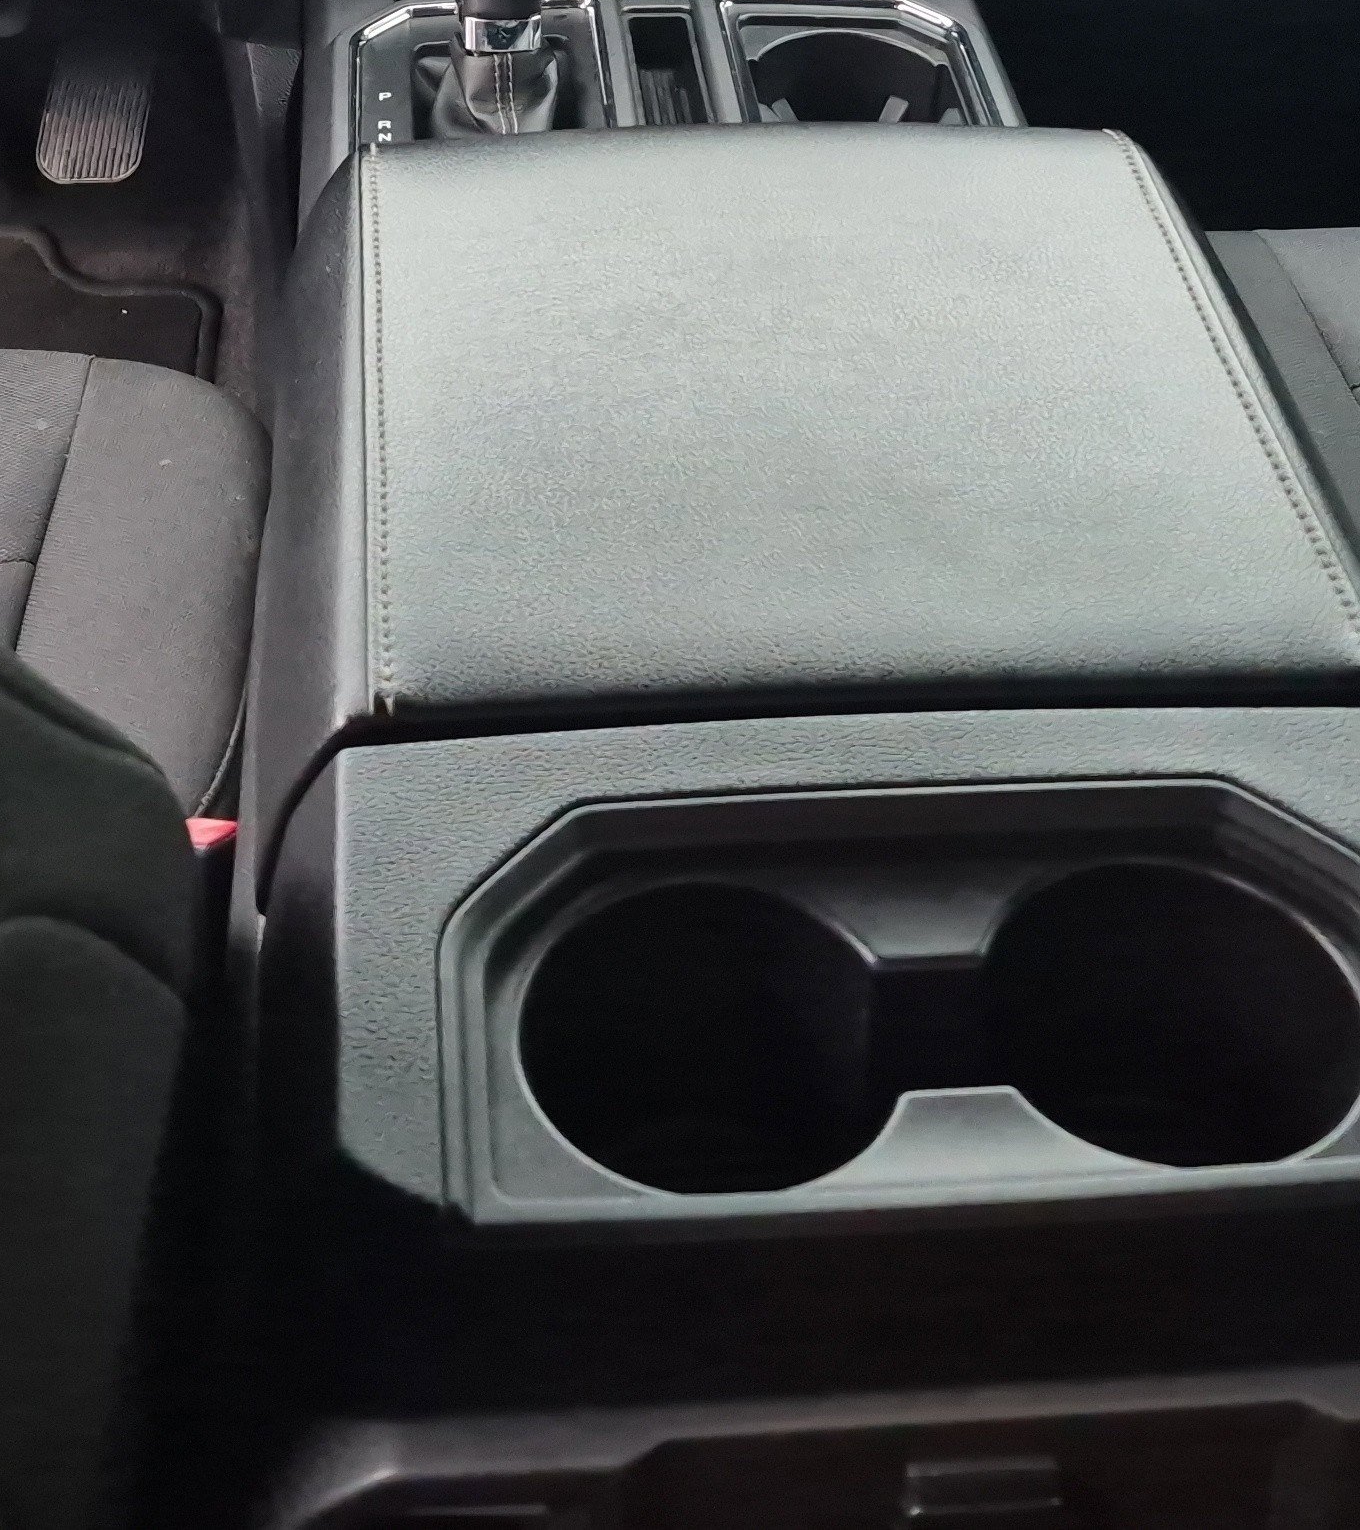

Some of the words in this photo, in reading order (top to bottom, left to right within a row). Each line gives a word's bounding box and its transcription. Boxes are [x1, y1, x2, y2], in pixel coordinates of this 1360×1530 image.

[378, 92, 392, 102] P
[378, 120, 392, 130] R
[378, 132, 392, 142] N
